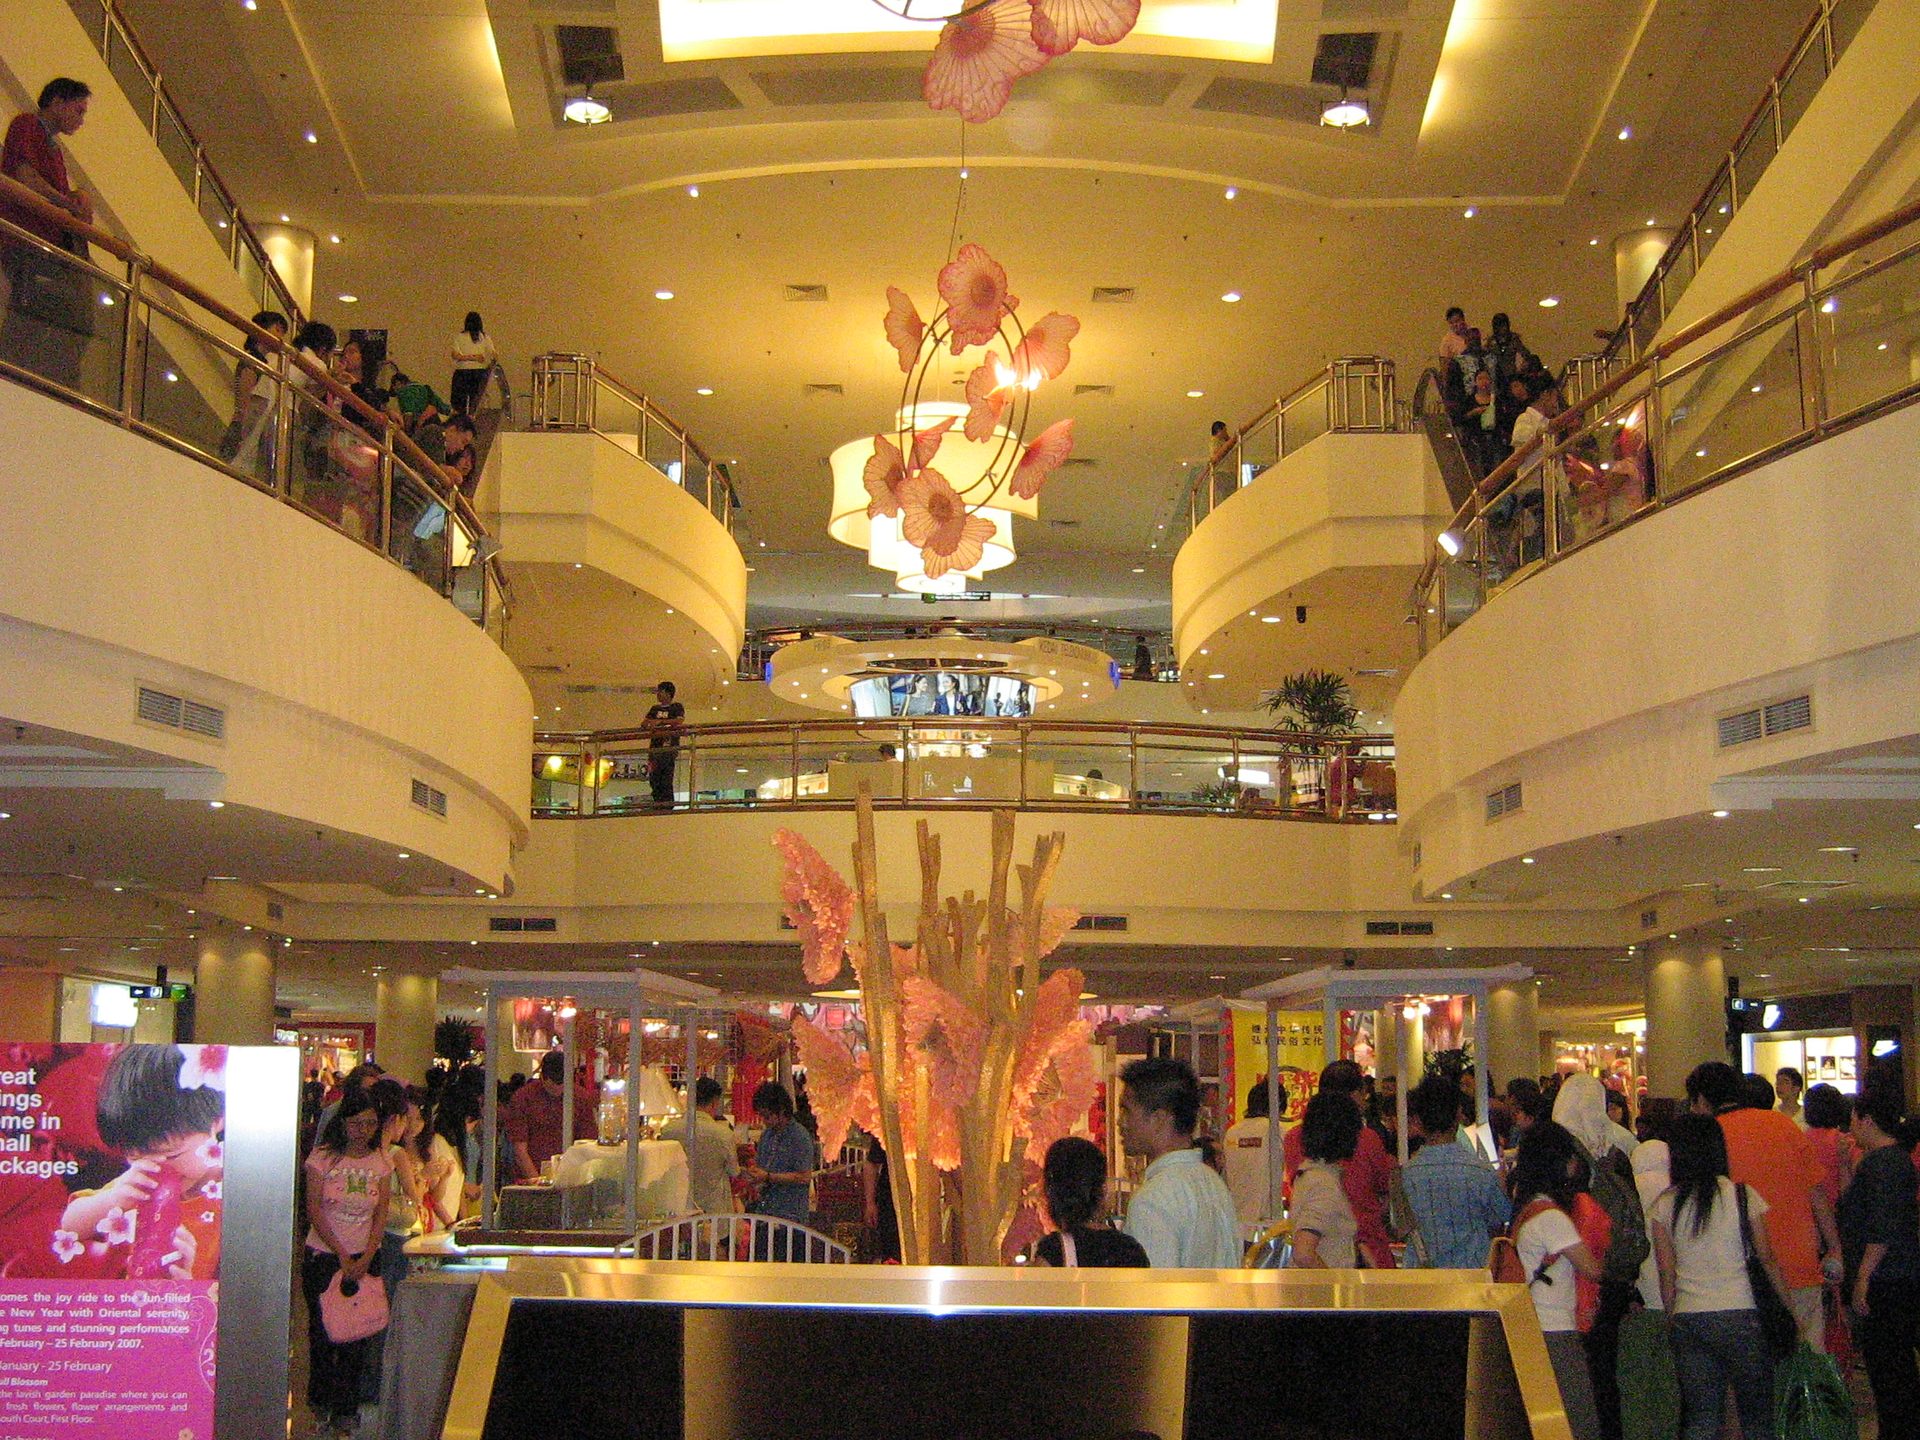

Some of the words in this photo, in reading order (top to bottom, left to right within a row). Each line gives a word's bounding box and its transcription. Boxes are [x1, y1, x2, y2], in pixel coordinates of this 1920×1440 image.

[0, 1068, 37, 1085] eat
[41, 1112, 61, 1130] in
[0, 1156, 79, 1179] ckages
[34, 1292, 50, 1302] the
[56, 1292, 73, 1305] joy
[78, 1292, 98, 1302] ride
[104, 1293, 115, 1302] to
[120, 1292, 137, 1302] the
[143, 1292, 191, 1303] fun-filled
[10, 1308, 35, 1317] New
[40, 1308, 64, 1317] Year
[70, 1308, 94, 1317] with
[99, 1308, 142, 1317] Oriental
[146, 1308, 190, 1320] serenity,
[14, 1324, 42, 1333] tunes
[46, 1323, 66, 1333] and
[70, 1323, 115, 1335] stunning
[120, 1323, 190, 1335] performances
[0, 1339, 44, 1350] February
[55, 1339, 67, 1348] 25
[70, 1339, 115, 1350] February
[117, 1339, 144, 1348] 2007.
[49, 1362, 62, 1371] 25
[64, 1361, 112, 1374] February
[11, 1377, 48, 1386] Blossom
[45, 1390, 76, 1400] garden
[80, 1390, 117, 1400] paradise
[121, 1391, 147, 1399] where
[152, 1392, 168, 1400] you
[6, 1402, 28, 1411] fresh
[72, 1402, 99, 1411] flower
[105, 1403, 165, 1413] arrangements
[170, 1402, 188, 1411] and
[51, 1414, 69, 1423] First
